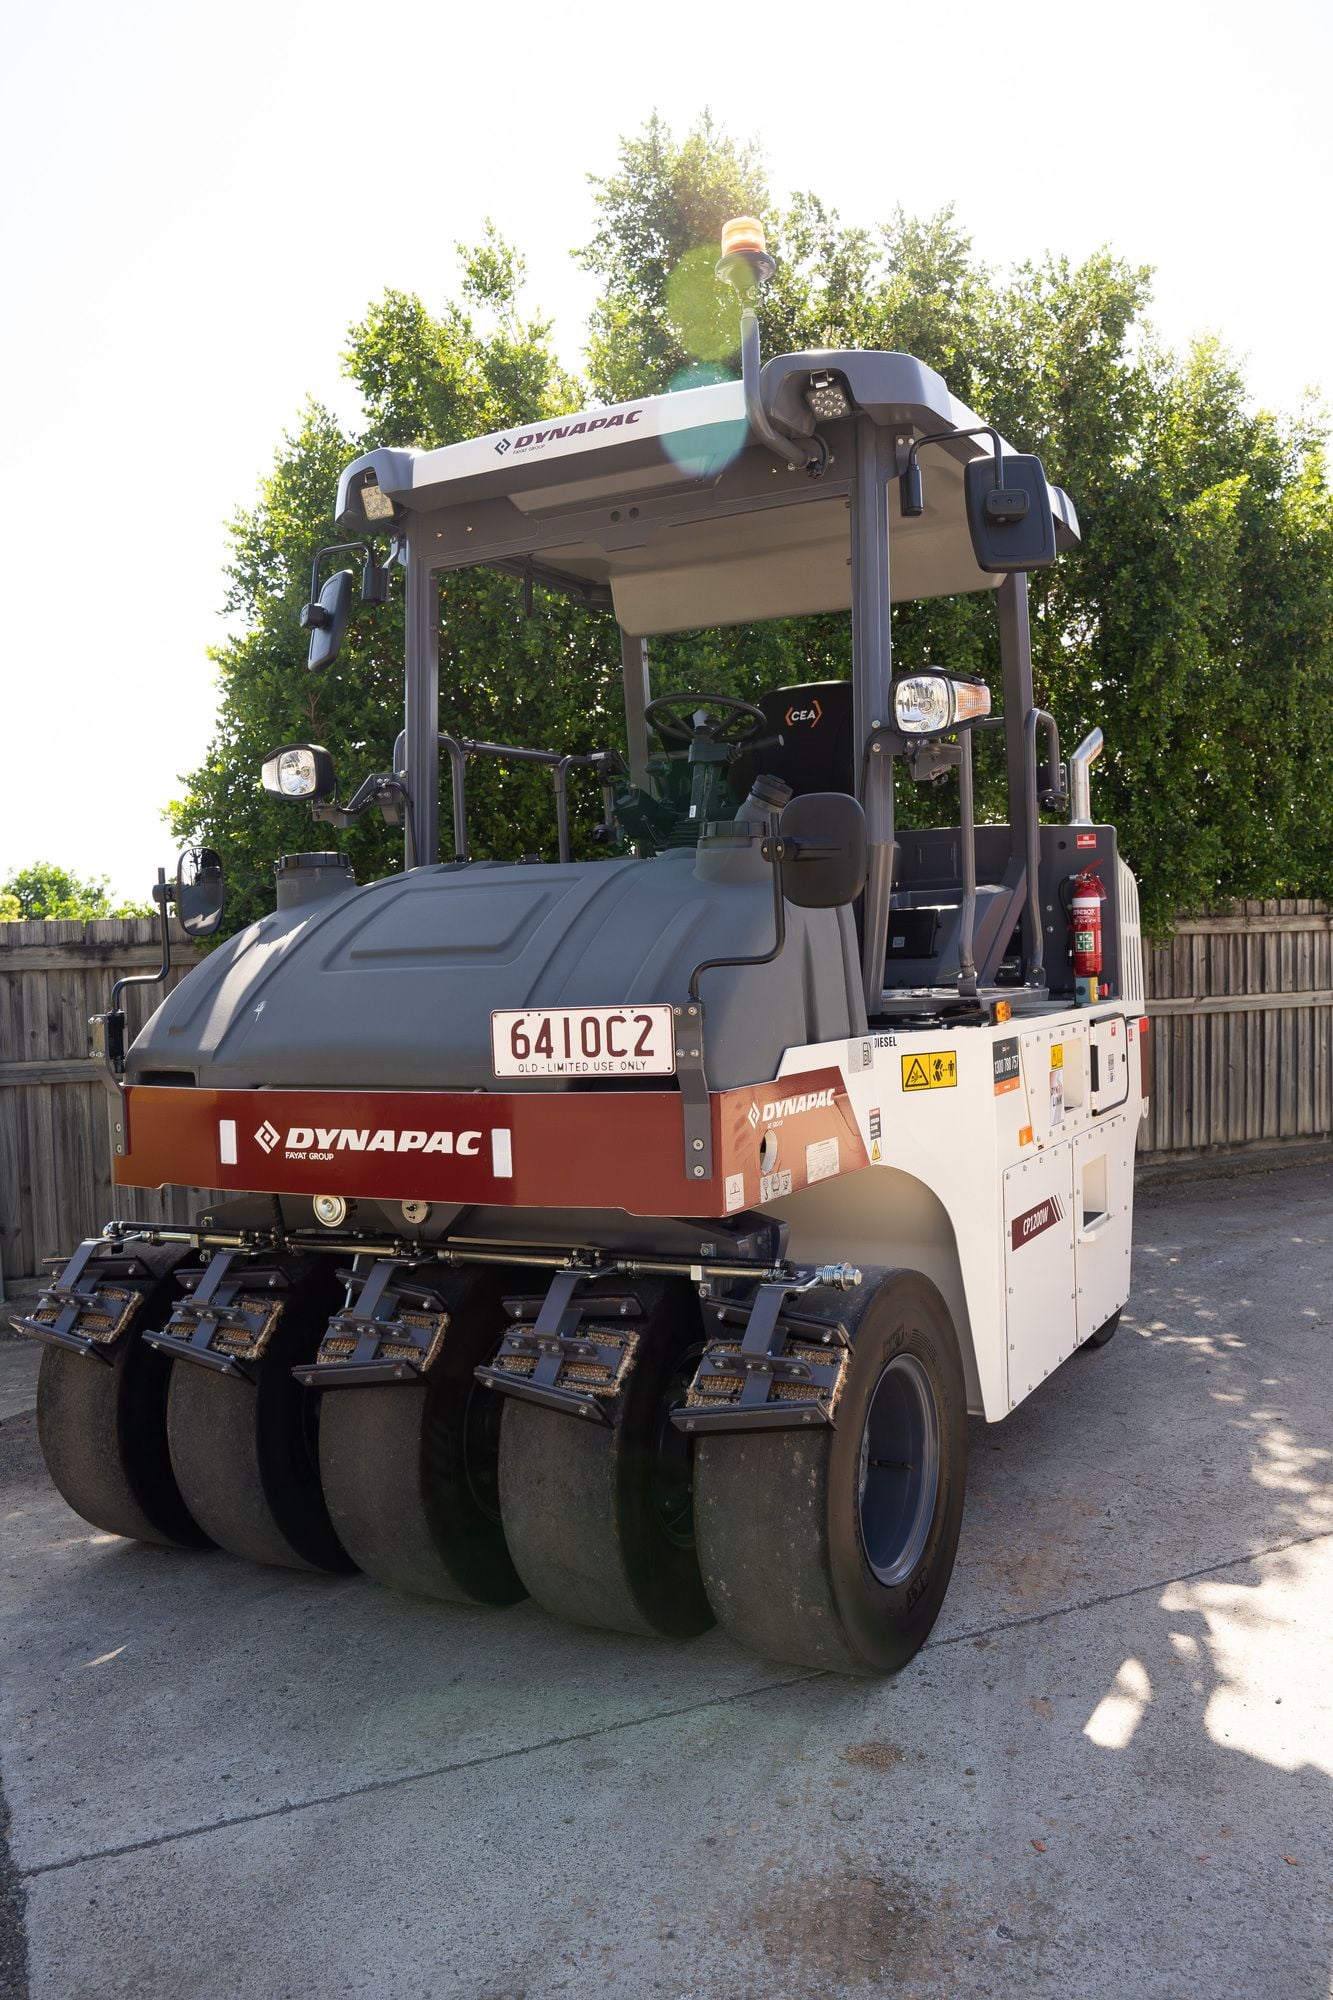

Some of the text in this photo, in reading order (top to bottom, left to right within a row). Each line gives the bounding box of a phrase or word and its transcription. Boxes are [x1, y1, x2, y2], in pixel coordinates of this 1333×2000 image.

[514, 409, 643, 449] DYNAPAC
[528, 444, 546, 452] GROUP
[791, 709, 816, 721] CEA
[511, 1014, 655, 1060] 6410C2
[874, 1036, 897, 1048] DIESEL
[594, 1061, 614, 1072] USE
[620, 1060, 647, 1071] ONLY
[762, 1088, 836, 1122] DYNAPAC
[285, 1127, 482, 1156] DYNAPAC
[285, 1151, 334, 1161] FAYAT GROUP
[1022, 1205, 1049, 1236] CP1200W
